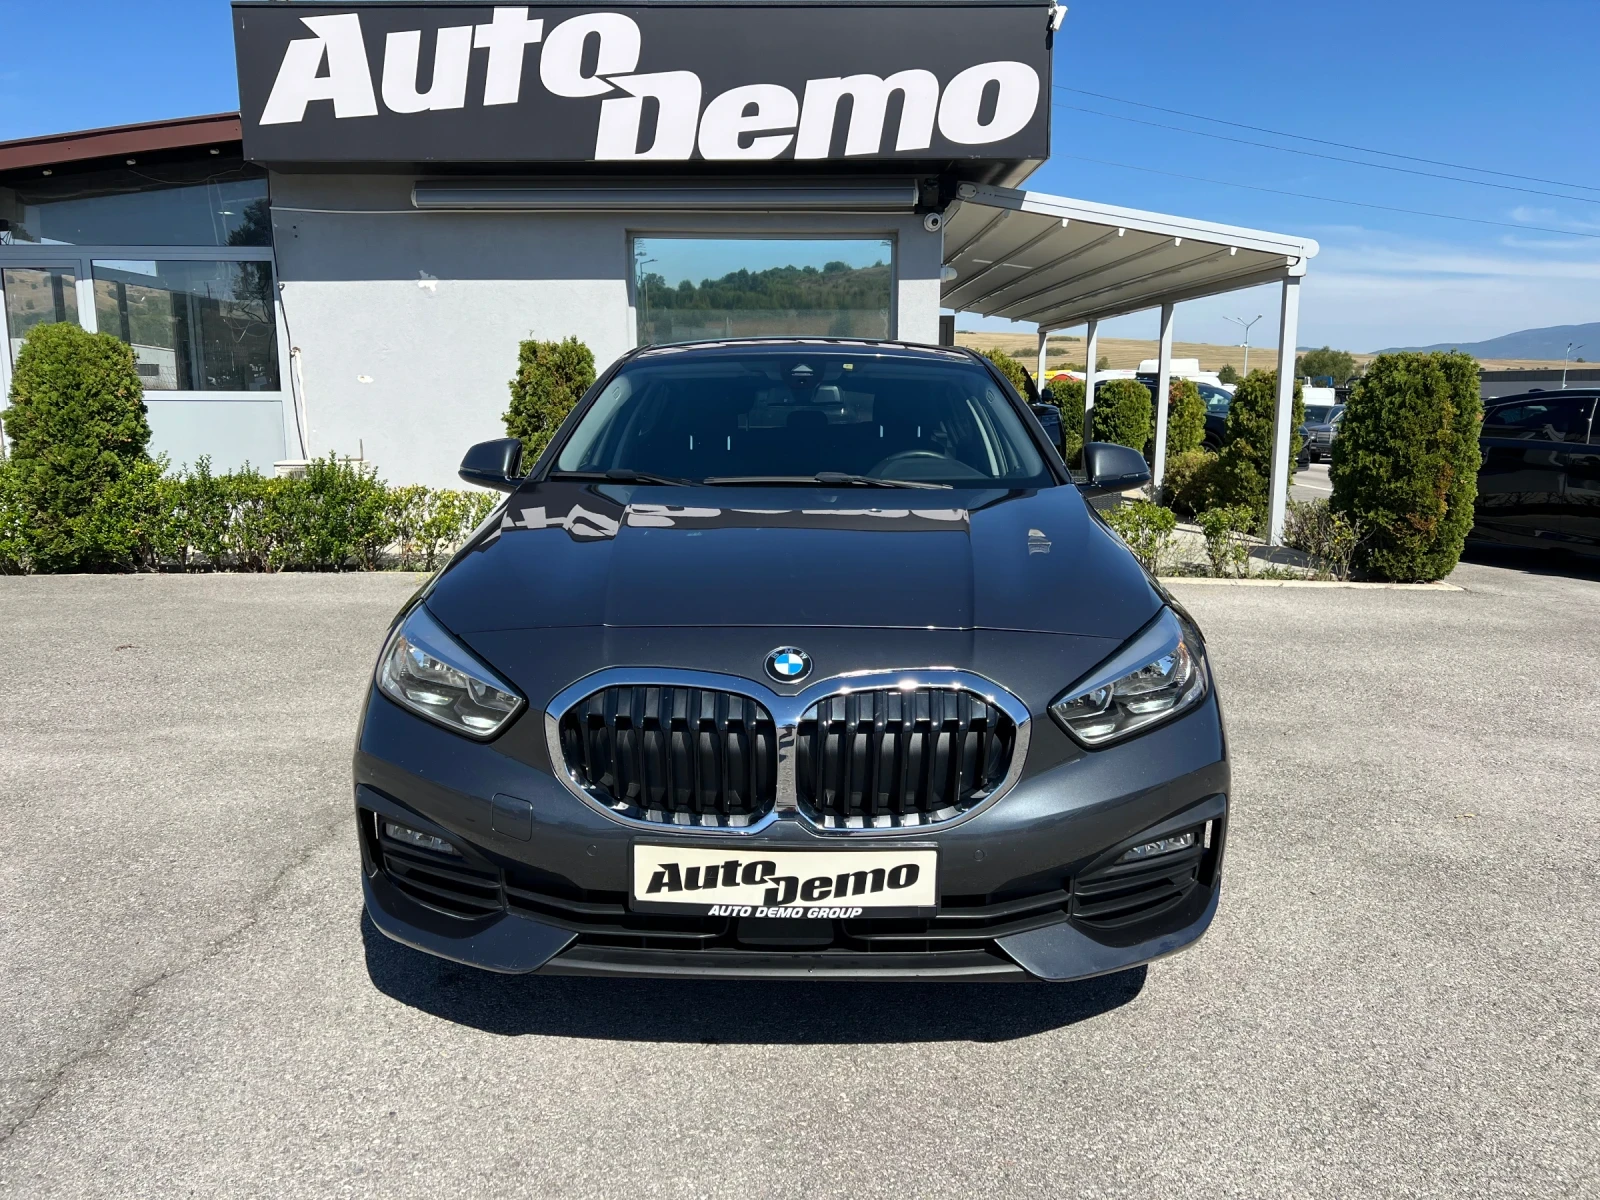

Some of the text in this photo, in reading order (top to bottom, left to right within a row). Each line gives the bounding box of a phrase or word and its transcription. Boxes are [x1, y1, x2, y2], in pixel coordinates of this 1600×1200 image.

[259, 5, 1040, 161] Auto Demo
[771, 648, 808, 660] BMW
[646, 860, 920, 906] Auto Demo
[708, 905, 863, 919] AUTO DEMO GROUP
